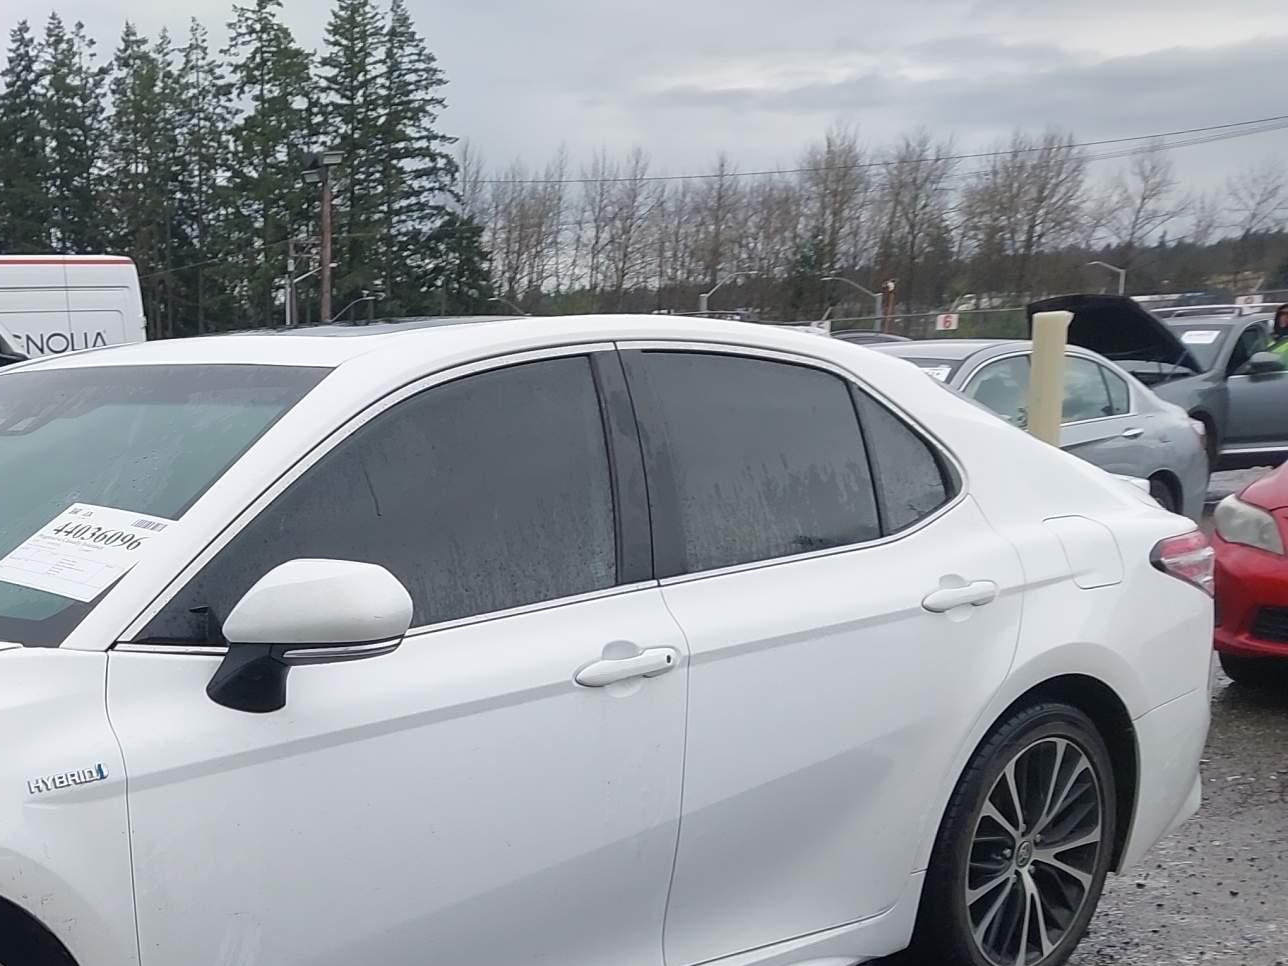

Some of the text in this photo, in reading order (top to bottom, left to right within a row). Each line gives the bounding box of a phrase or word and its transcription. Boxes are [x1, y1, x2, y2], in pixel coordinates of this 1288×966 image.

[943, 314, 953, 329] 6
[12, 329, 107, 355] NOLIA
[53, 521, 150, 551] 44036096
[27, 768, 98, 794] HYBRID
